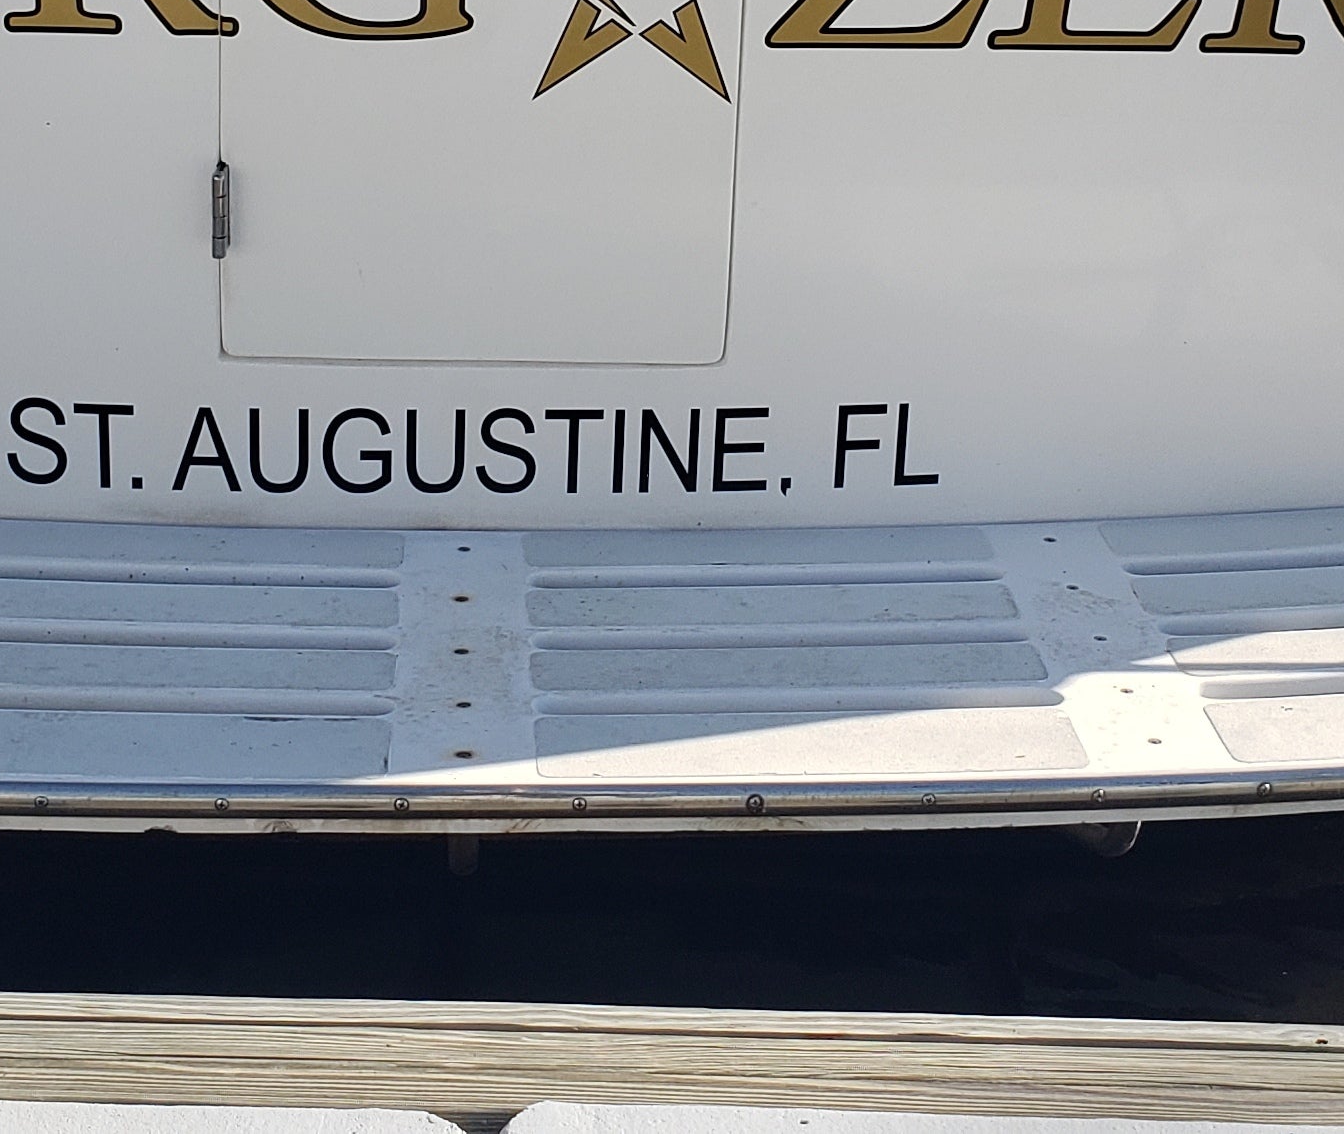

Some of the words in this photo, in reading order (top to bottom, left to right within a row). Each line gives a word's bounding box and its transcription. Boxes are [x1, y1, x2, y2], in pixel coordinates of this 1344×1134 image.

[6, 397, 144, 490] ST.
[171, 405, 792, 497] AUGUSTINE,
[833, 402, 940, 489] FL
